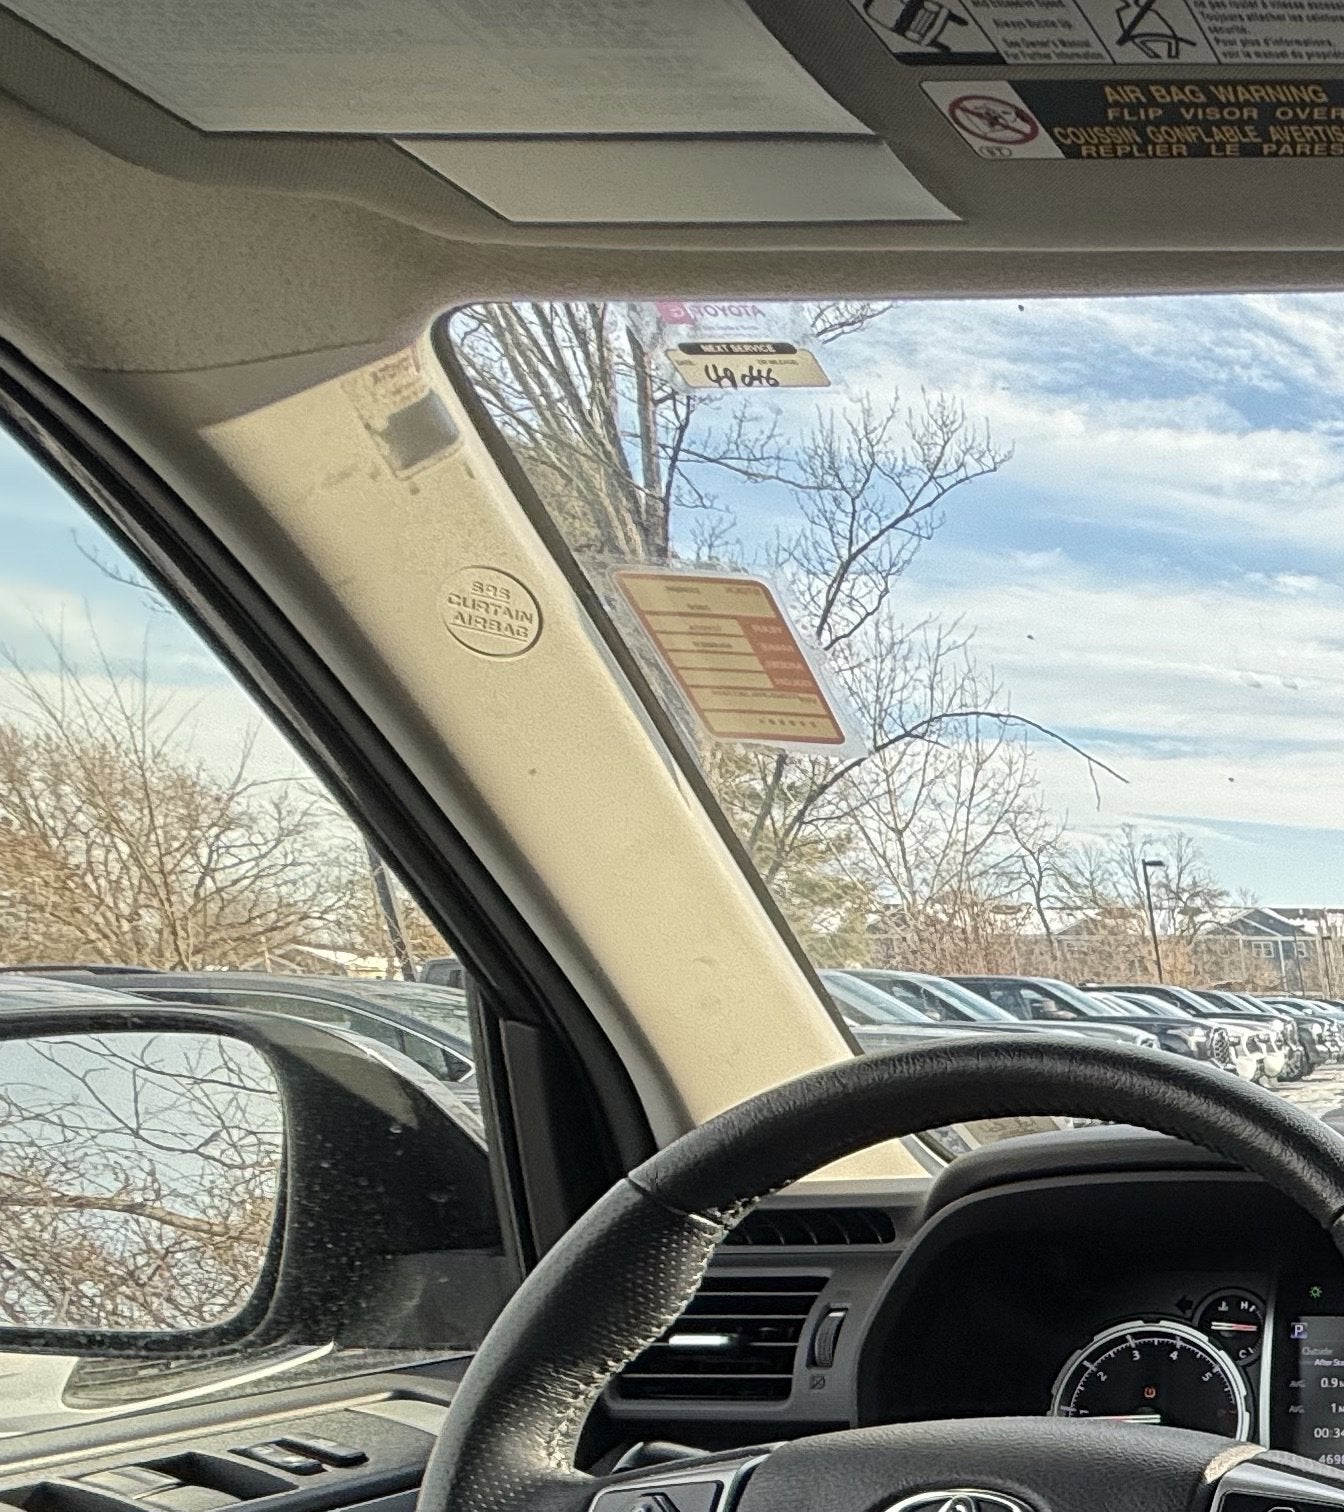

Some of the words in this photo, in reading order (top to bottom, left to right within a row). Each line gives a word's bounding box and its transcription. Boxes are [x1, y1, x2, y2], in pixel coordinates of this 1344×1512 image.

[1104, 86, 1147, 103] AIR
[1150, 86, 1204, 103] BAG
[1211, 85, 1328, 103] WARNING
[1107, 107, 1163, 120] FLIP
[1180, 107, 1258, 120] VISOR
[1053, 127, 1143, 145] COUSSIN
[1147, 127, 1262, 145] GONFLABLE
[1081, 144, 1188, 157] REPLIER
[1211, 144, 1240, 157] LE
[700, 344, 729, 353] NEXT
[732, 344, 777, 354] SERVICE
[447, 592, 533, 624] CURTAIN
[454, 611, 529, 638] AIRBAG
[1294, 1324, 1304, 1336] P
[1132, 1350, 1141, 1361] 3
[1169, 1350, 1178, 1360] 4
[1097, 1371, 1108, 1382] 2
[1201, 1372, 1212, 1382] 5
